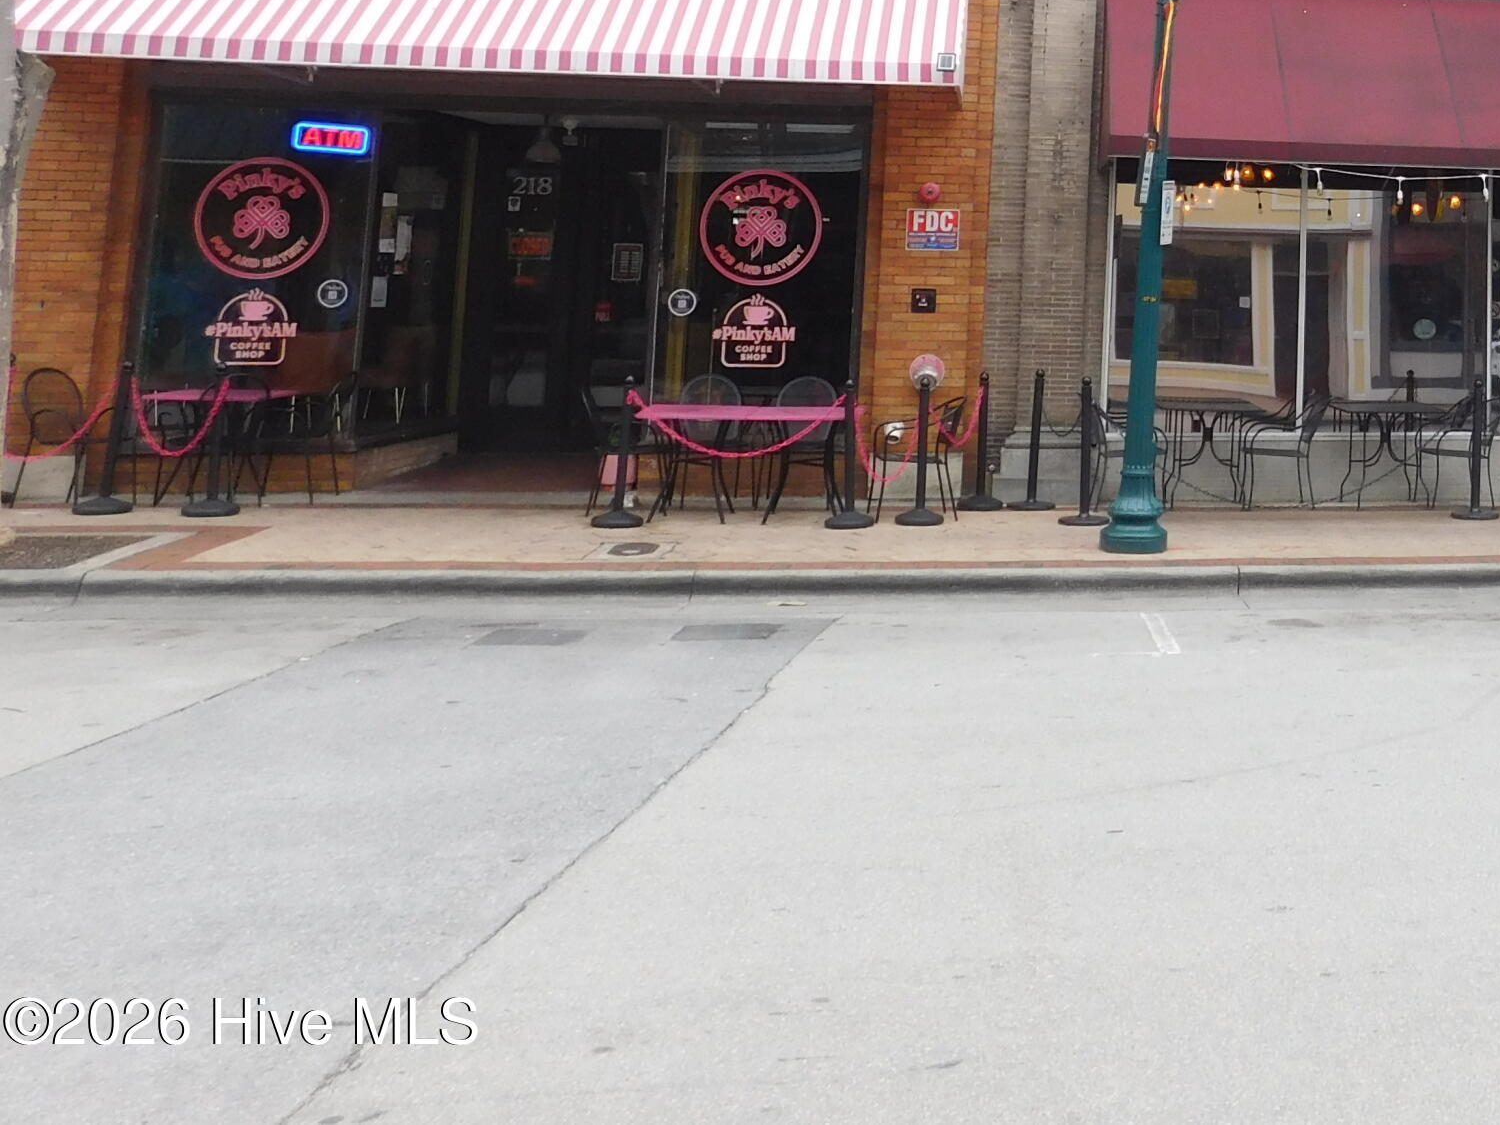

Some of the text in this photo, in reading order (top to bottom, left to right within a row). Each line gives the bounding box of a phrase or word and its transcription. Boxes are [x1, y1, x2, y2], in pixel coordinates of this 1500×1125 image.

[303, 127, 363, 149] ATM
[218, 168, 306, 201] Pinky's
[513, 176, 552, 195] 218
[720, 179, 800, 210] Pinky's
[912, 210, 954, 232] FDC
[209, 235, 309, 268] PUB AND EATERY
[715, 244, 805, 275] PUB AND EATERY
[205, 322, 297, 341] #Pinky'sAM
[712, 326, 797, 344] #Pinky'sAM
[230, 341, 271, 351] COFFEE
[235, 350, 265, 359] SHOP
[734, 345, 772, 354] COFFEE
[740, 353, 767, 362] SHOP
